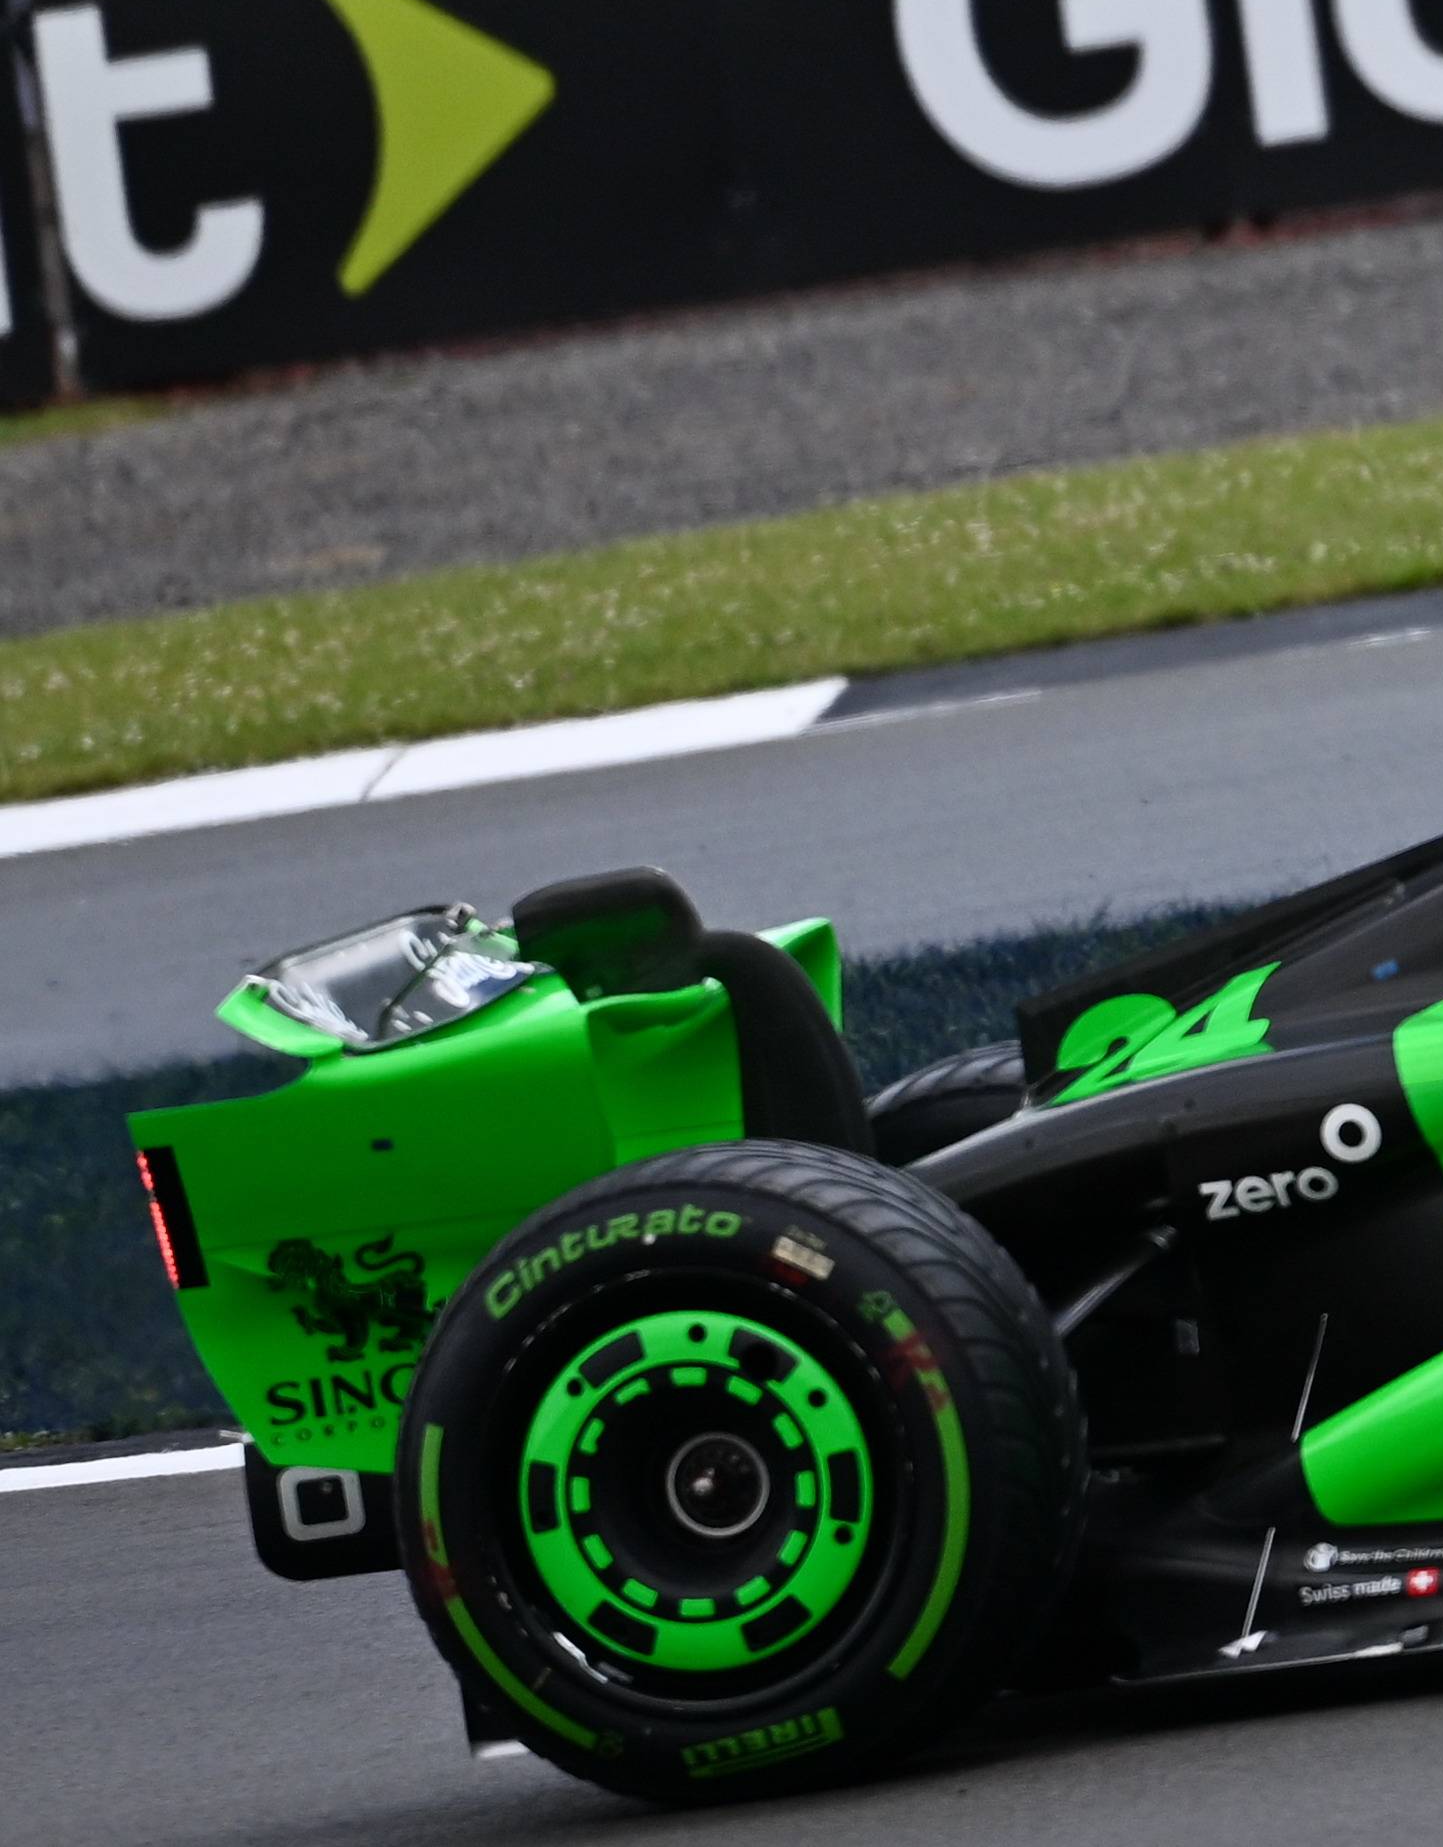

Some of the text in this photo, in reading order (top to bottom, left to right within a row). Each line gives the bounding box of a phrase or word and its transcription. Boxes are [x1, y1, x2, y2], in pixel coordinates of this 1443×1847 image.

[1042, 960, 1281, 1107] 24
[485, 1202, 743, 1320] Cinturato
[1300, 1575, 1403, 1606] Swiss made
